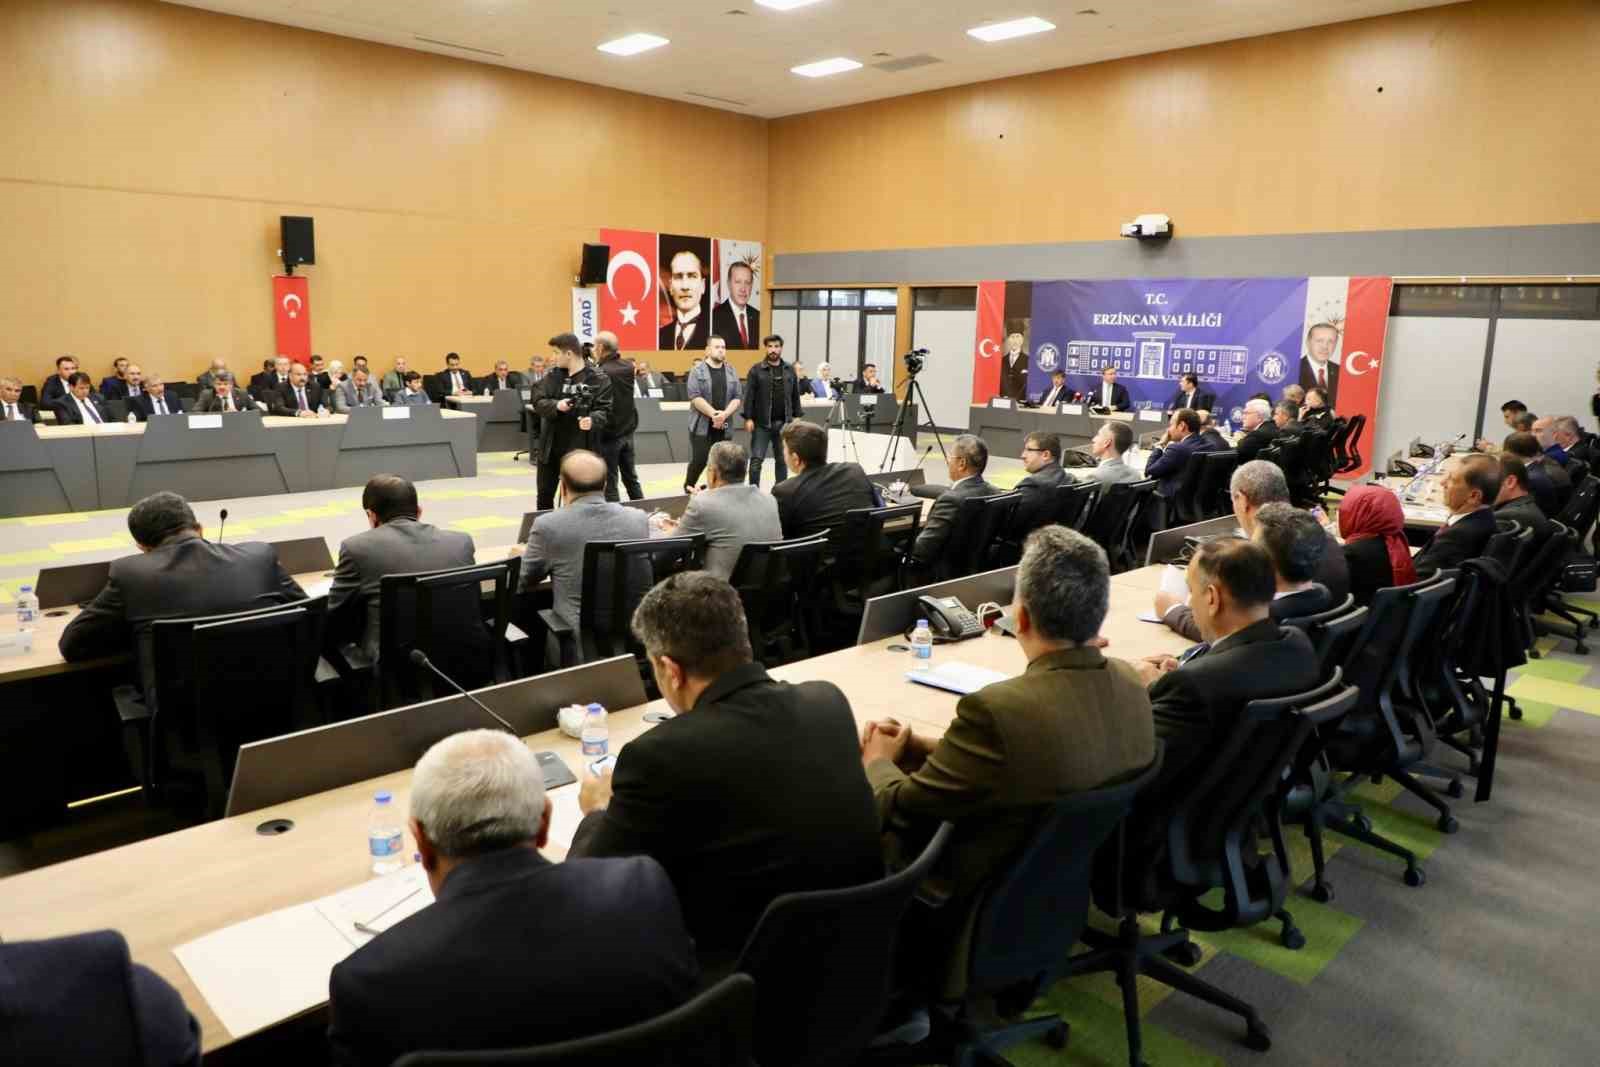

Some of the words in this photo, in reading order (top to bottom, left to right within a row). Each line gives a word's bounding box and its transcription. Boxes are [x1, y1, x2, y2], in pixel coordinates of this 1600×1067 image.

[1145, 293, 1169, 305] T.C.
[582, 300, 592, 337] AFAD
[1093, 312, 1158, 326] ERZİNCAN
[1161, 312, 1222, 327] VALİLİĞİ
